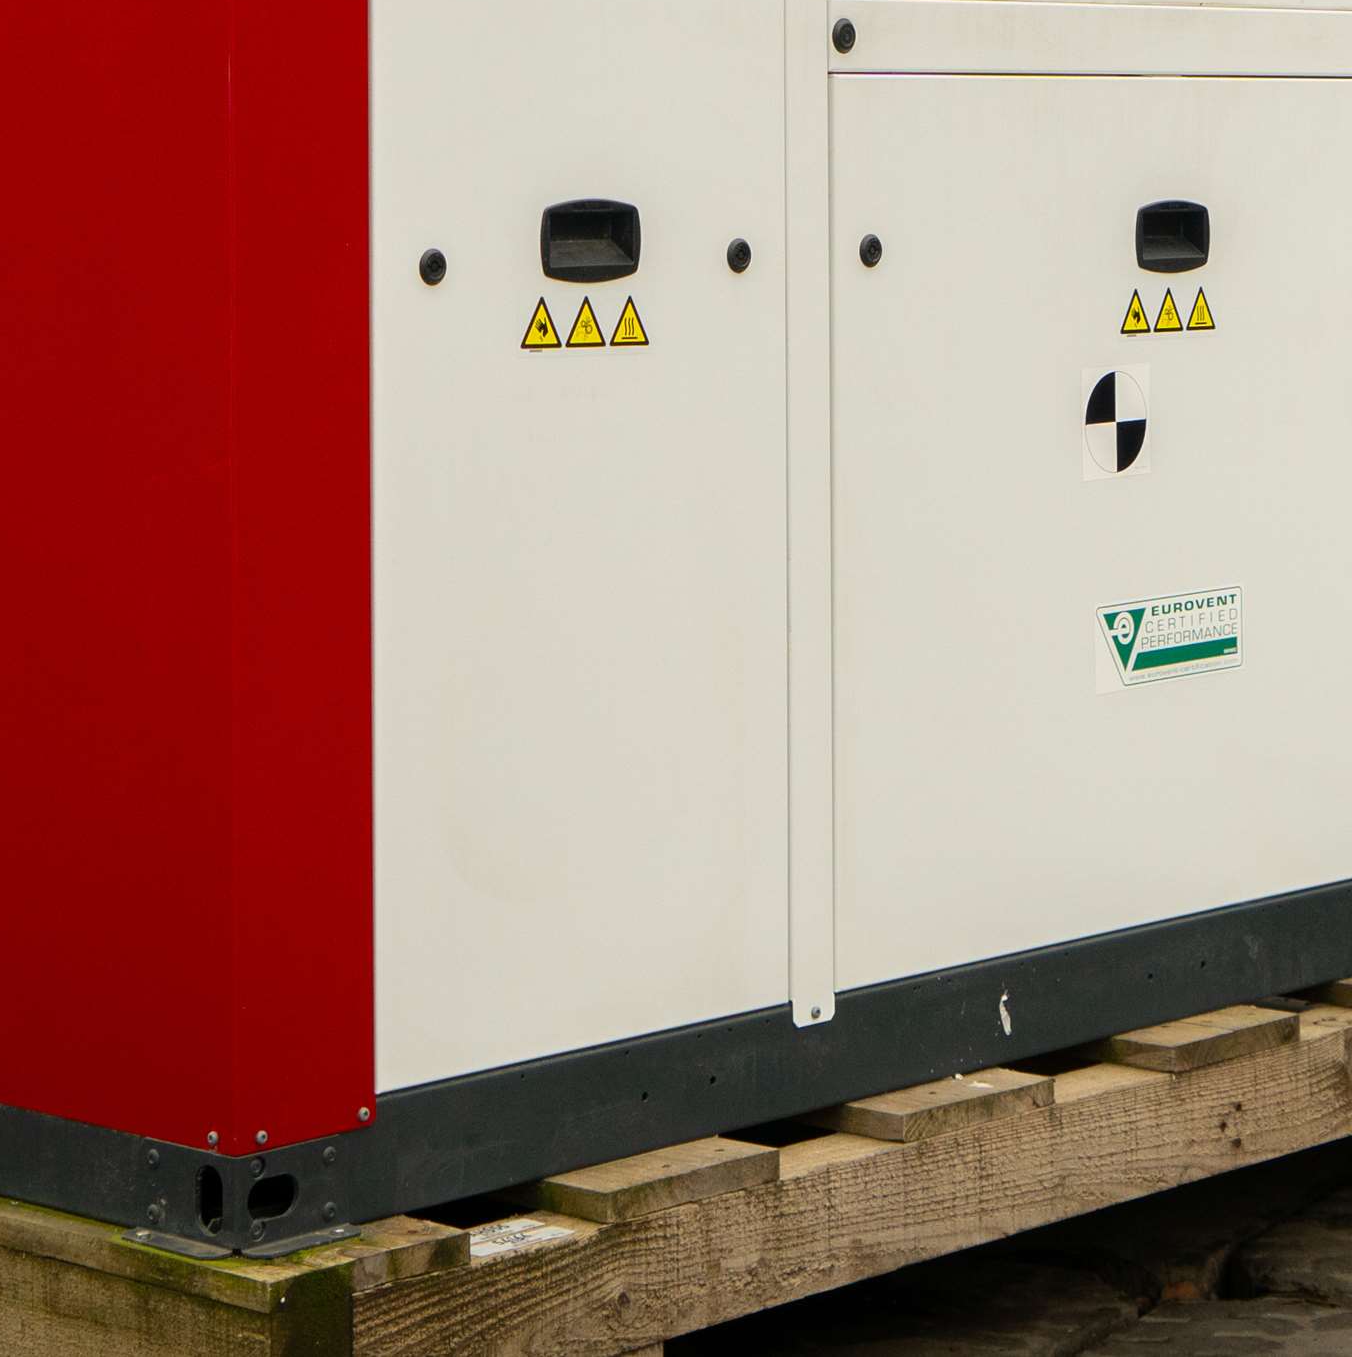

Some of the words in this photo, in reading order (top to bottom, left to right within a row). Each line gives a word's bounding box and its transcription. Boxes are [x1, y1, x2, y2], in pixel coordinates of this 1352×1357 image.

[1151, 593, 1238, 617] EUROVENT
[1145, 608, 1238, 634] CERTIFIED
[1141, 622, 1238, 650] PERFORMANCE
